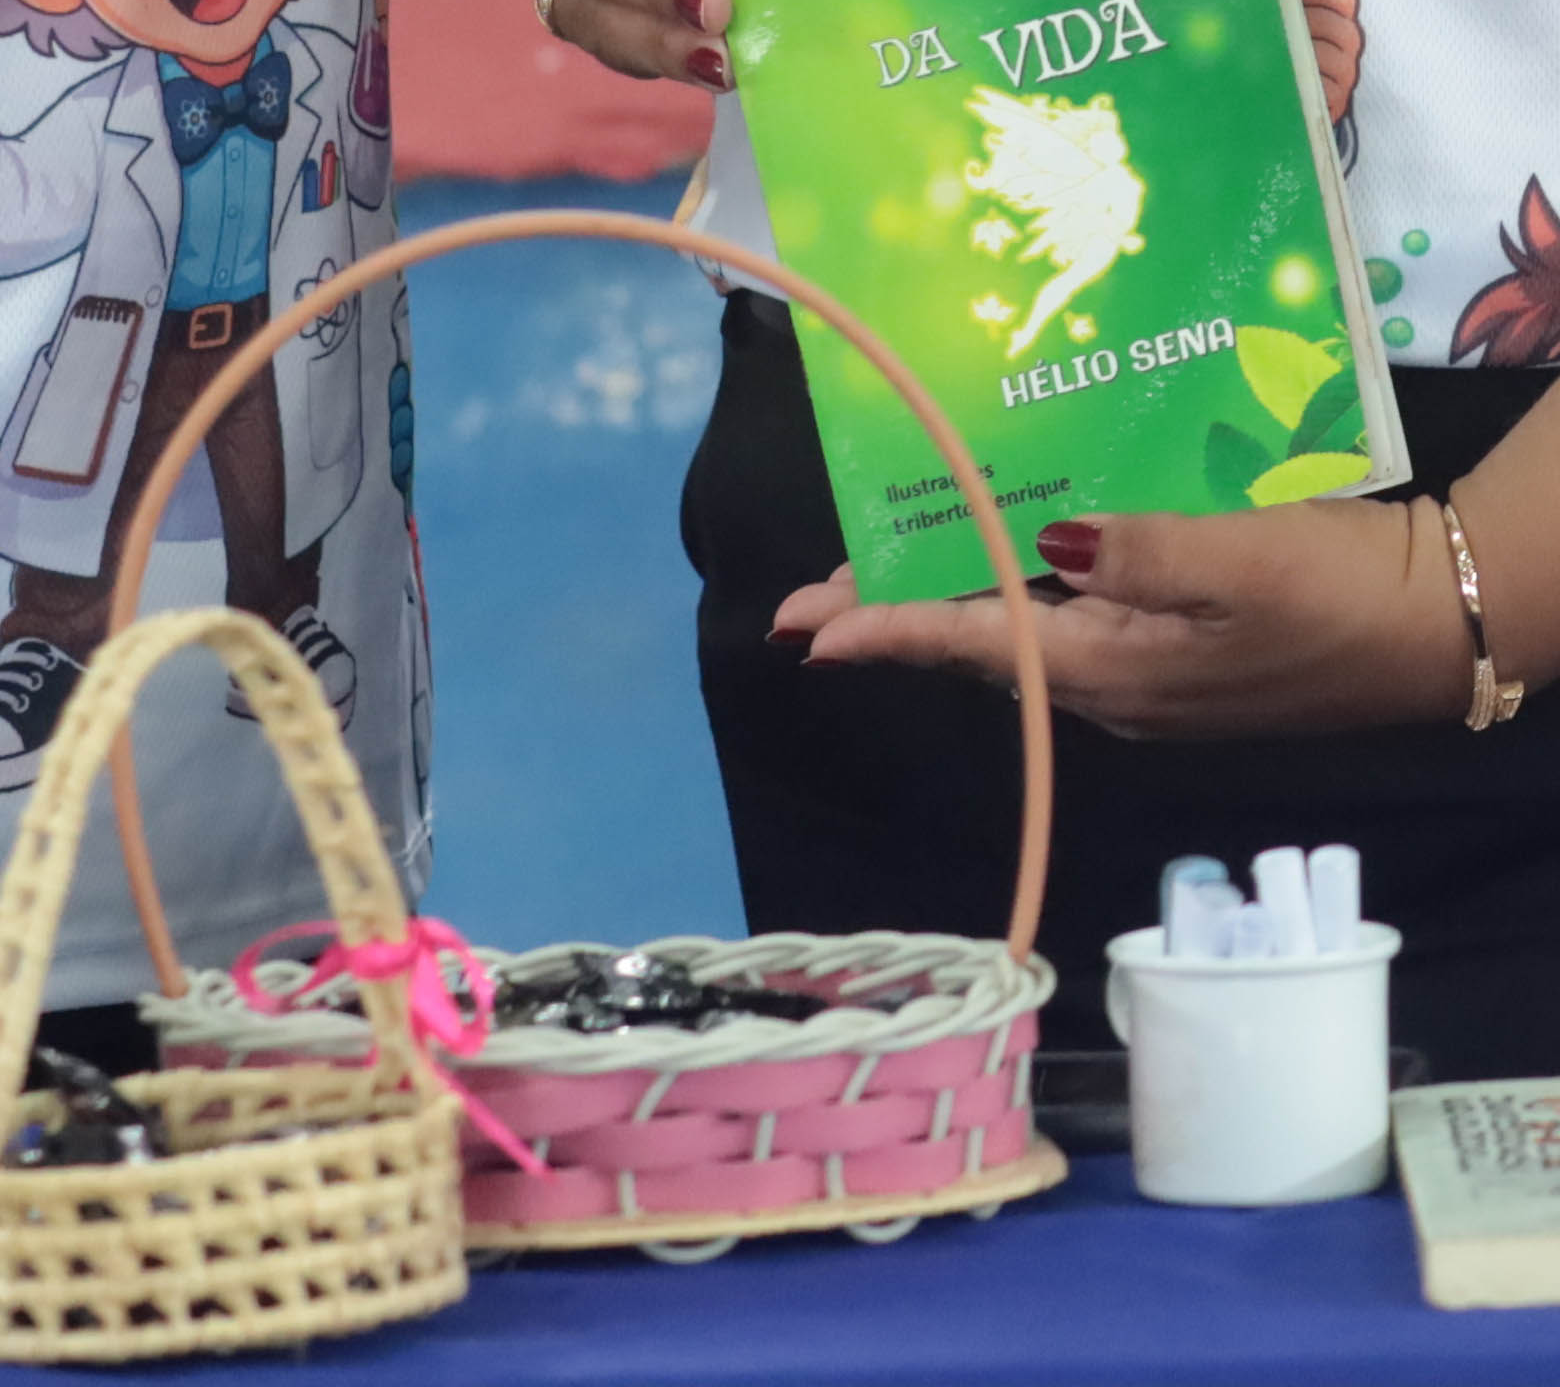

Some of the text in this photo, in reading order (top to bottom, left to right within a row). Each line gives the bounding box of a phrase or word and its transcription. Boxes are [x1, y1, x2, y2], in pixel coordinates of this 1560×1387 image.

[870, 26, 962, 90] DA
[999, 317, 1237, 410] HÉLIO SENA
[884, 463, 996, 505] Ilustraçs
[993, 476, 1073, 510] enrique
